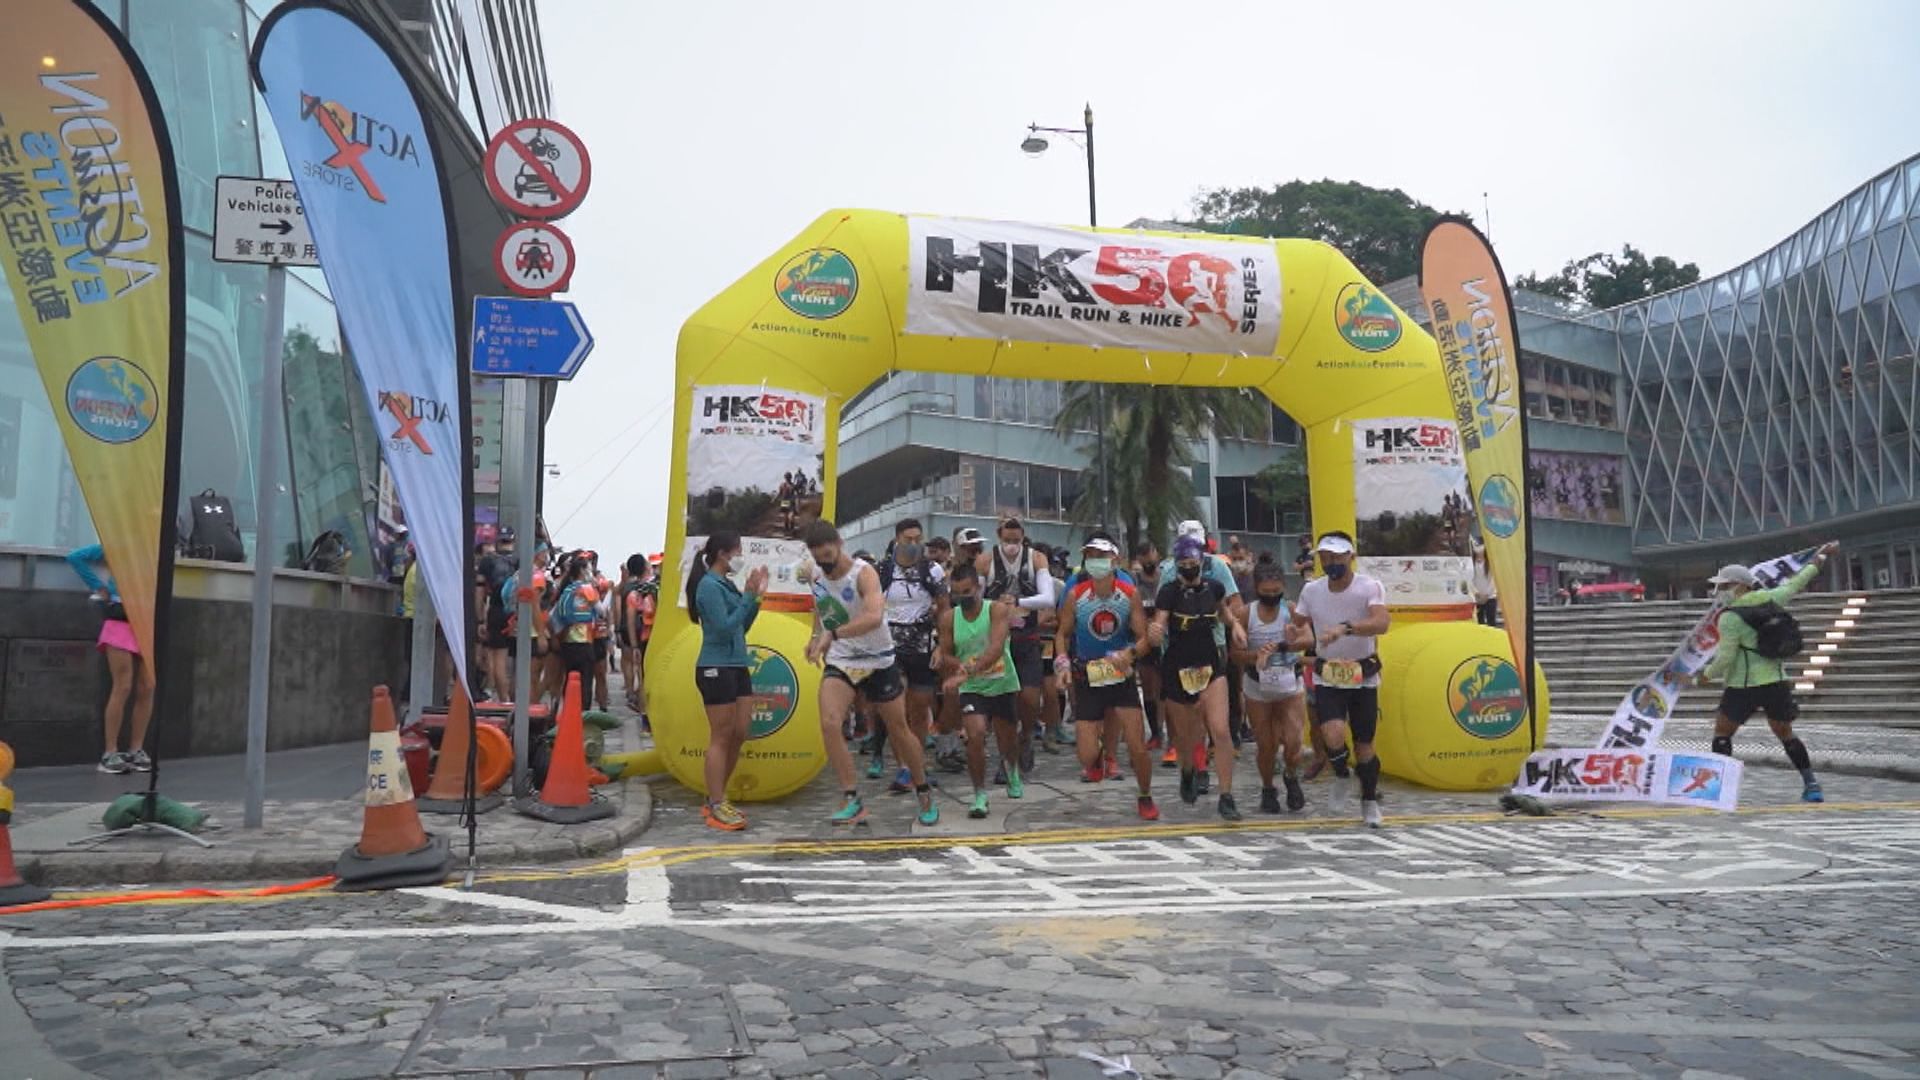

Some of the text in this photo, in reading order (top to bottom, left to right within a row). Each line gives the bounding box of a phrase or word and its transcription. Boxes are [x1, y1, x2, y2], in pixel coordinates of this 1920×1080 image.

[255, 185, 301, 200] Police
[228, 198, 292, 214] Vehicles
[791, 294, 836, 305] EVENTS
[1240, 257, 1256, 335] SERIES
[1010, 301, 1184, 328] TRAIL RUN & HIKE
[1351, 329, 1390, 338] EVENTS
[703, 393, 808, 424] HK50
[1468, 712, 1513, 725] EVENTS
